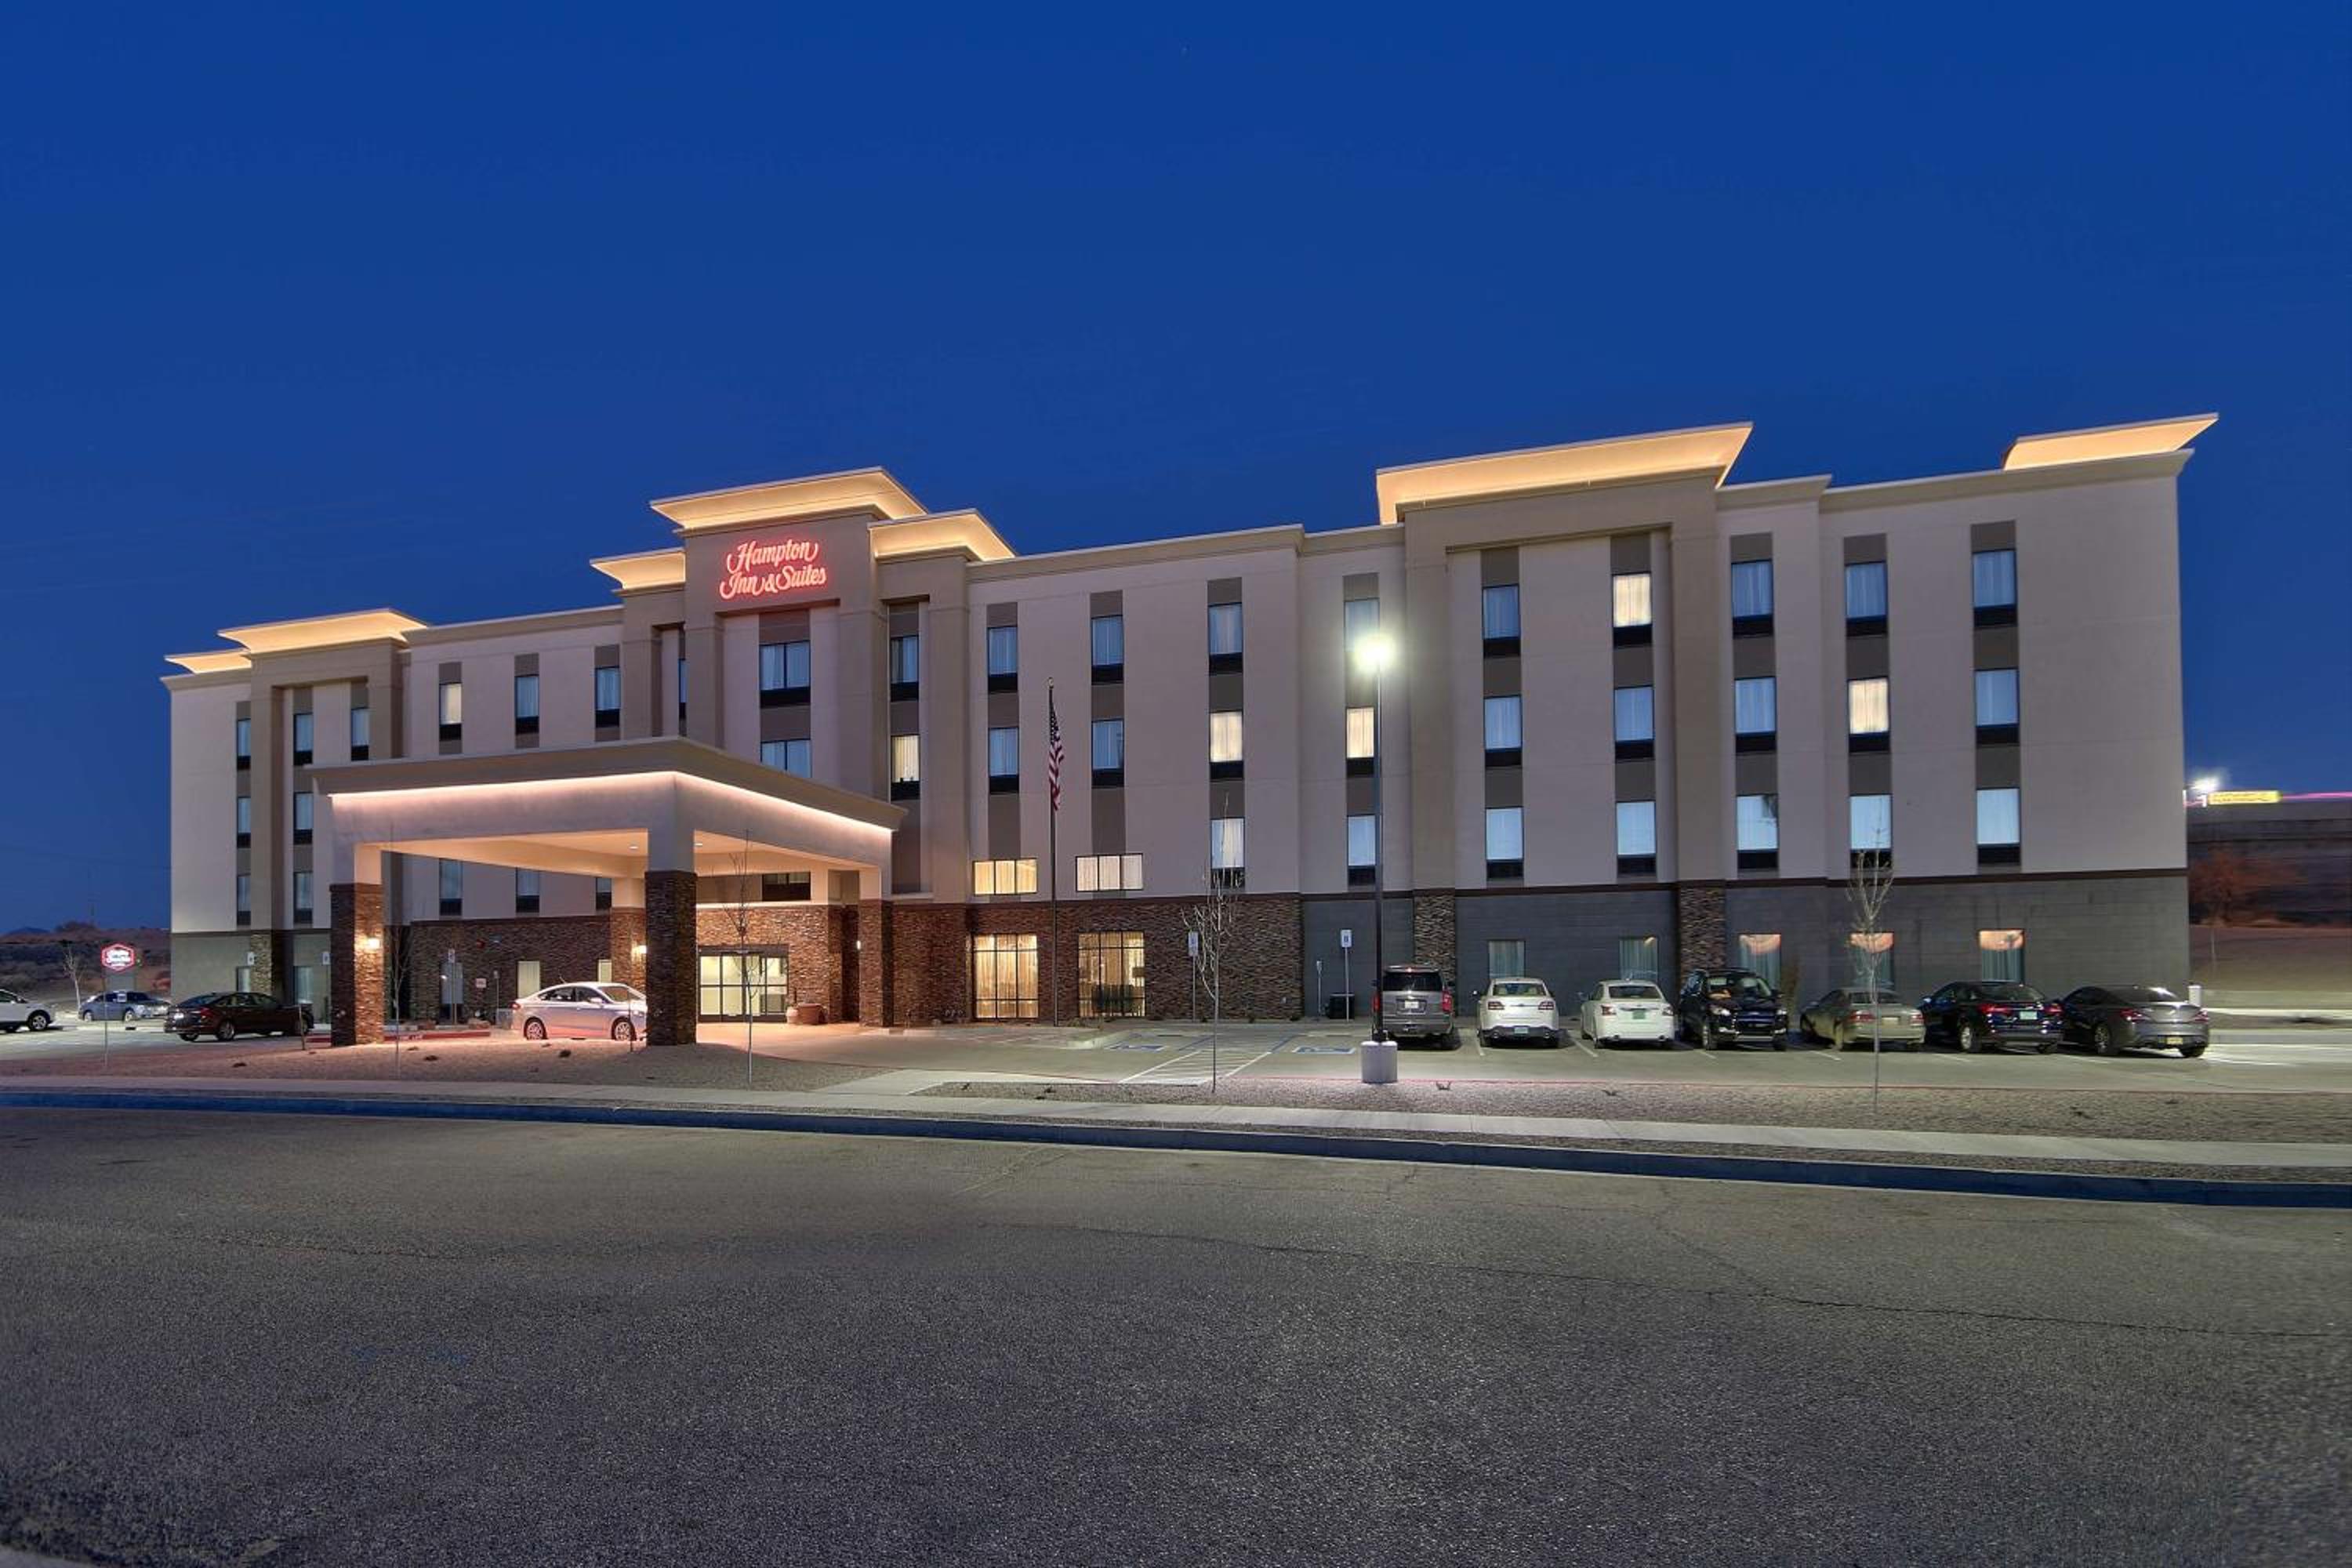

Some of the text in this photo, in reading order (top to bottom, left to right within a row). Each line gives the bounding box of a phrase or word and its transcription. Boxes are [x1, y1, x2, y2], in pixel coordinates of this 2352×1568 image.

[727, 539, 818, 574] Hampton
[720, 572, 765, 599] Inn
[775, 564, 827, 590] Suites
